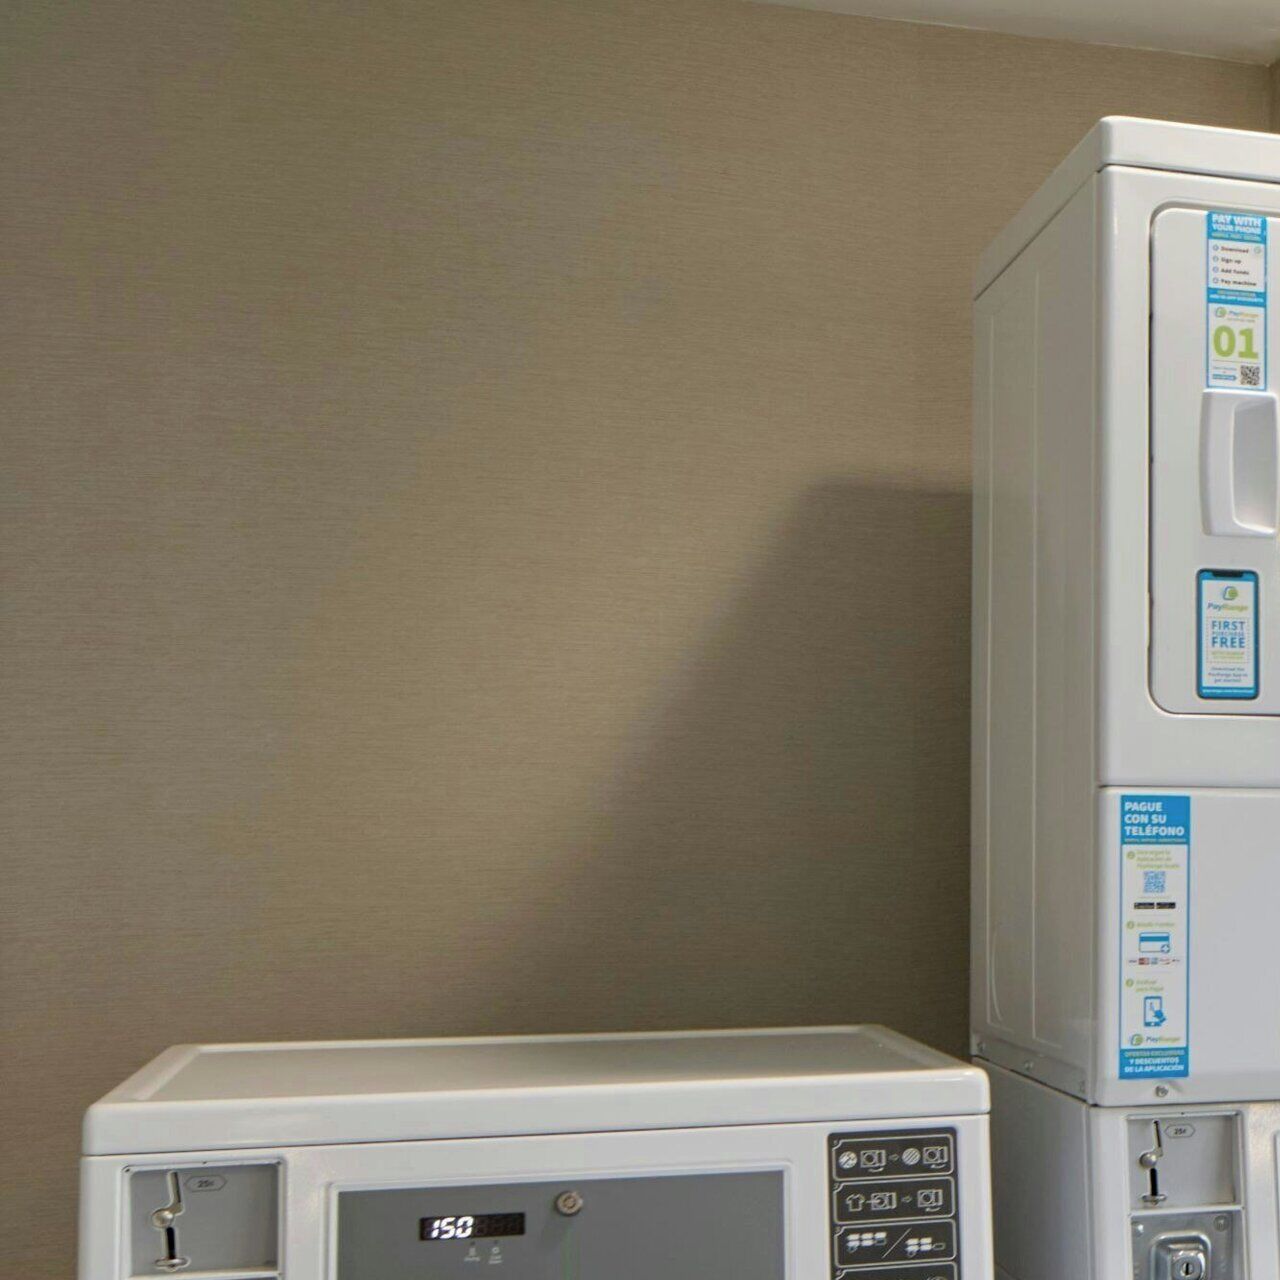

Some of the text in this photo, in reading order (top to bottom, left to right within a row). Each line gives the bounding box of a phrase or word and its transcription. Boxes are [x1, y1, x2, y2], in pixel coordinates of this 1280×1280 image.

[1213, 325, 1259, 359] 01
[1211, 620, 1246, 630] FIRST
[1211, 637, 1246, 648] FREE
[1125, 802, 1162, 811] PAGUE
[1124, 814, 1167, 824] CON SU
[1124, 824, 1185, 836] TELÉFONO
[431, 1216, 473, 1238] 150
